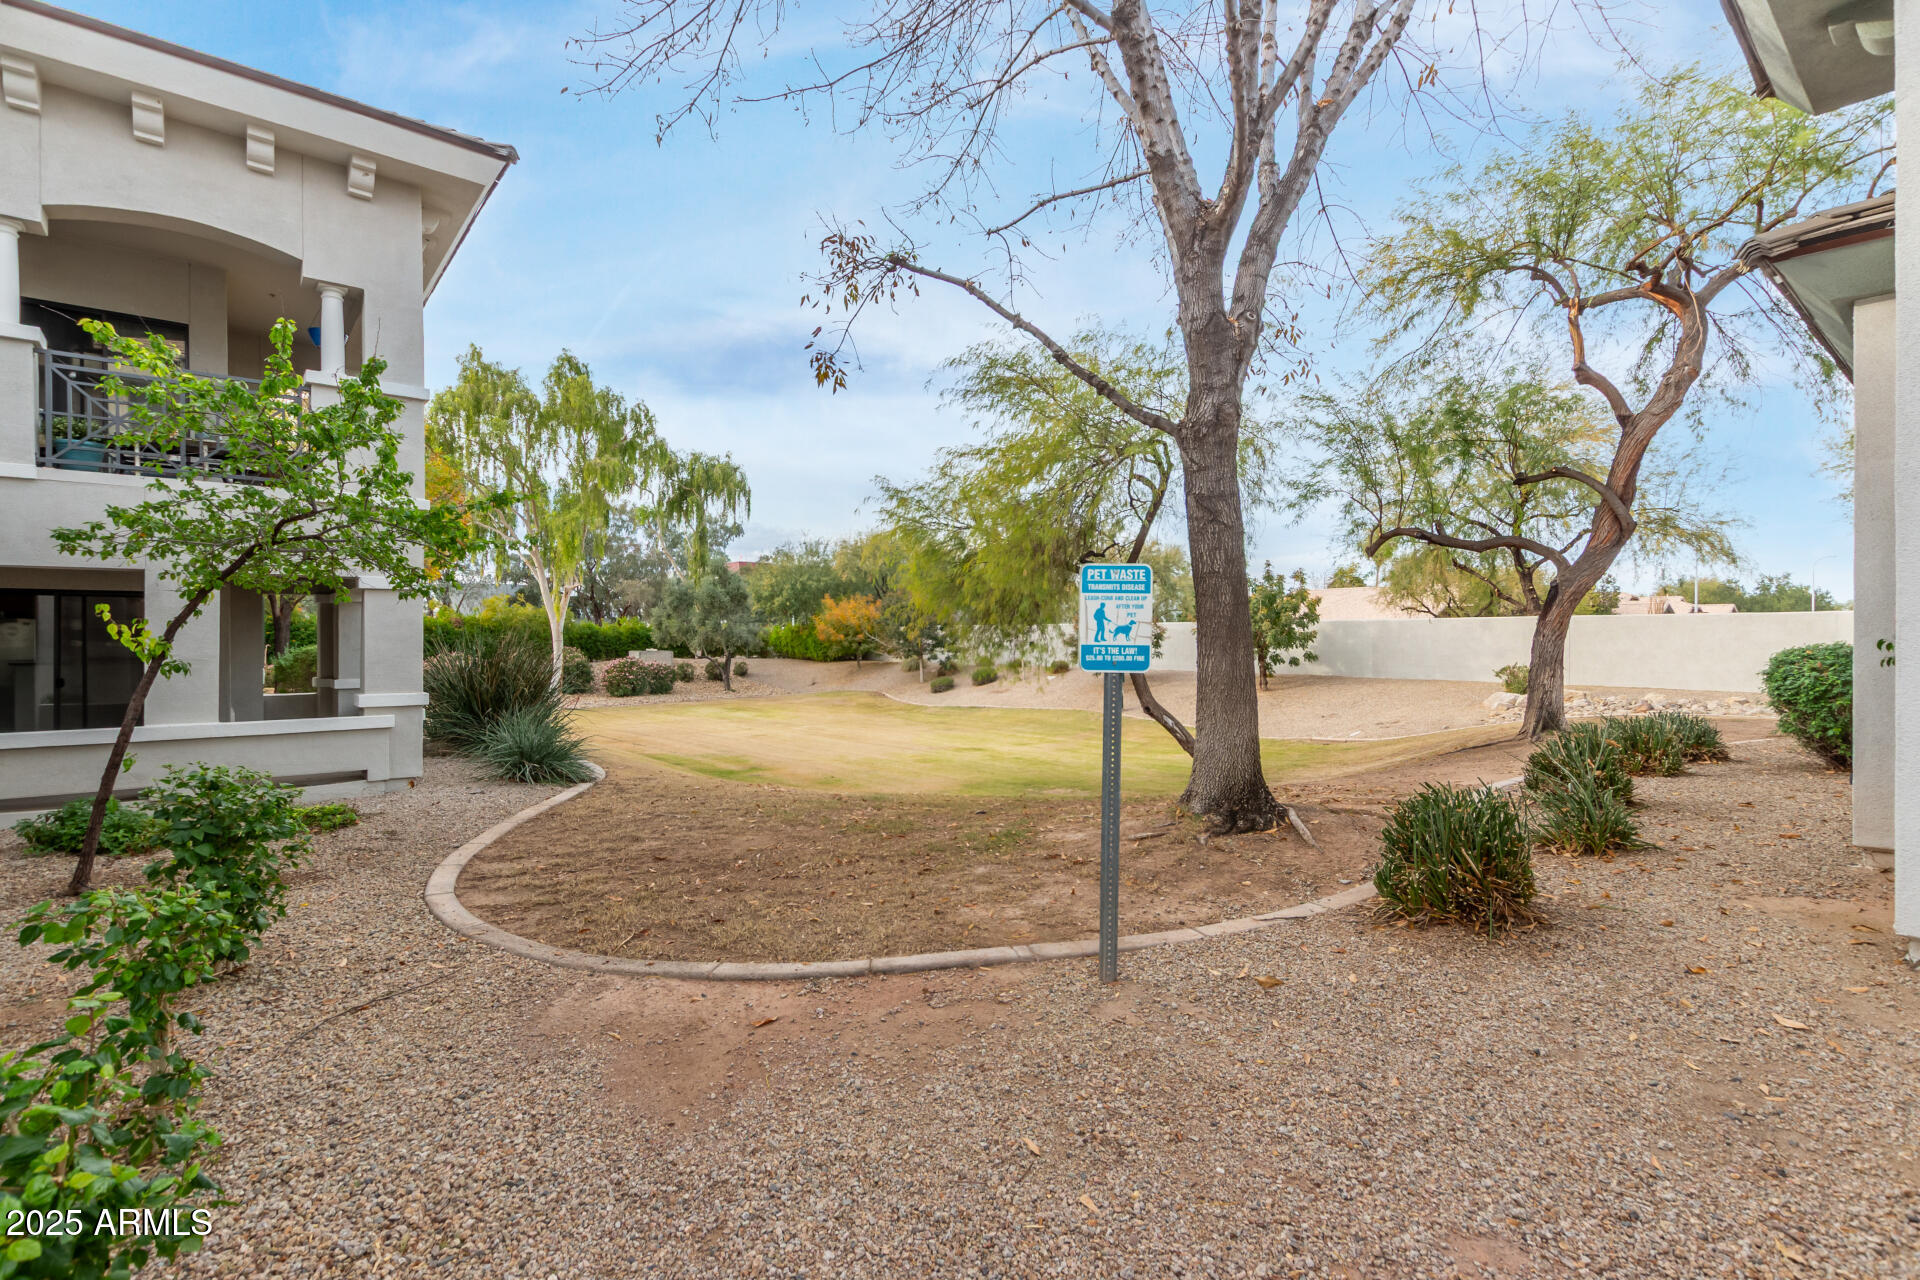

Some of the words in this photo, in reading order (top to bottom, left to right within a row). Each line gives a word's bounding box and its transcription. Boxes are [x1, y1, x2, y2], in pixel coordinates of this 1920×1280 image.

[1087, 569, 1107, 580] PET
[1110, 569, 1146, 580] WASTE
[1122, 583, 1145, 591] DISEASE
[1121, 647, 1137, 655] LAW!
